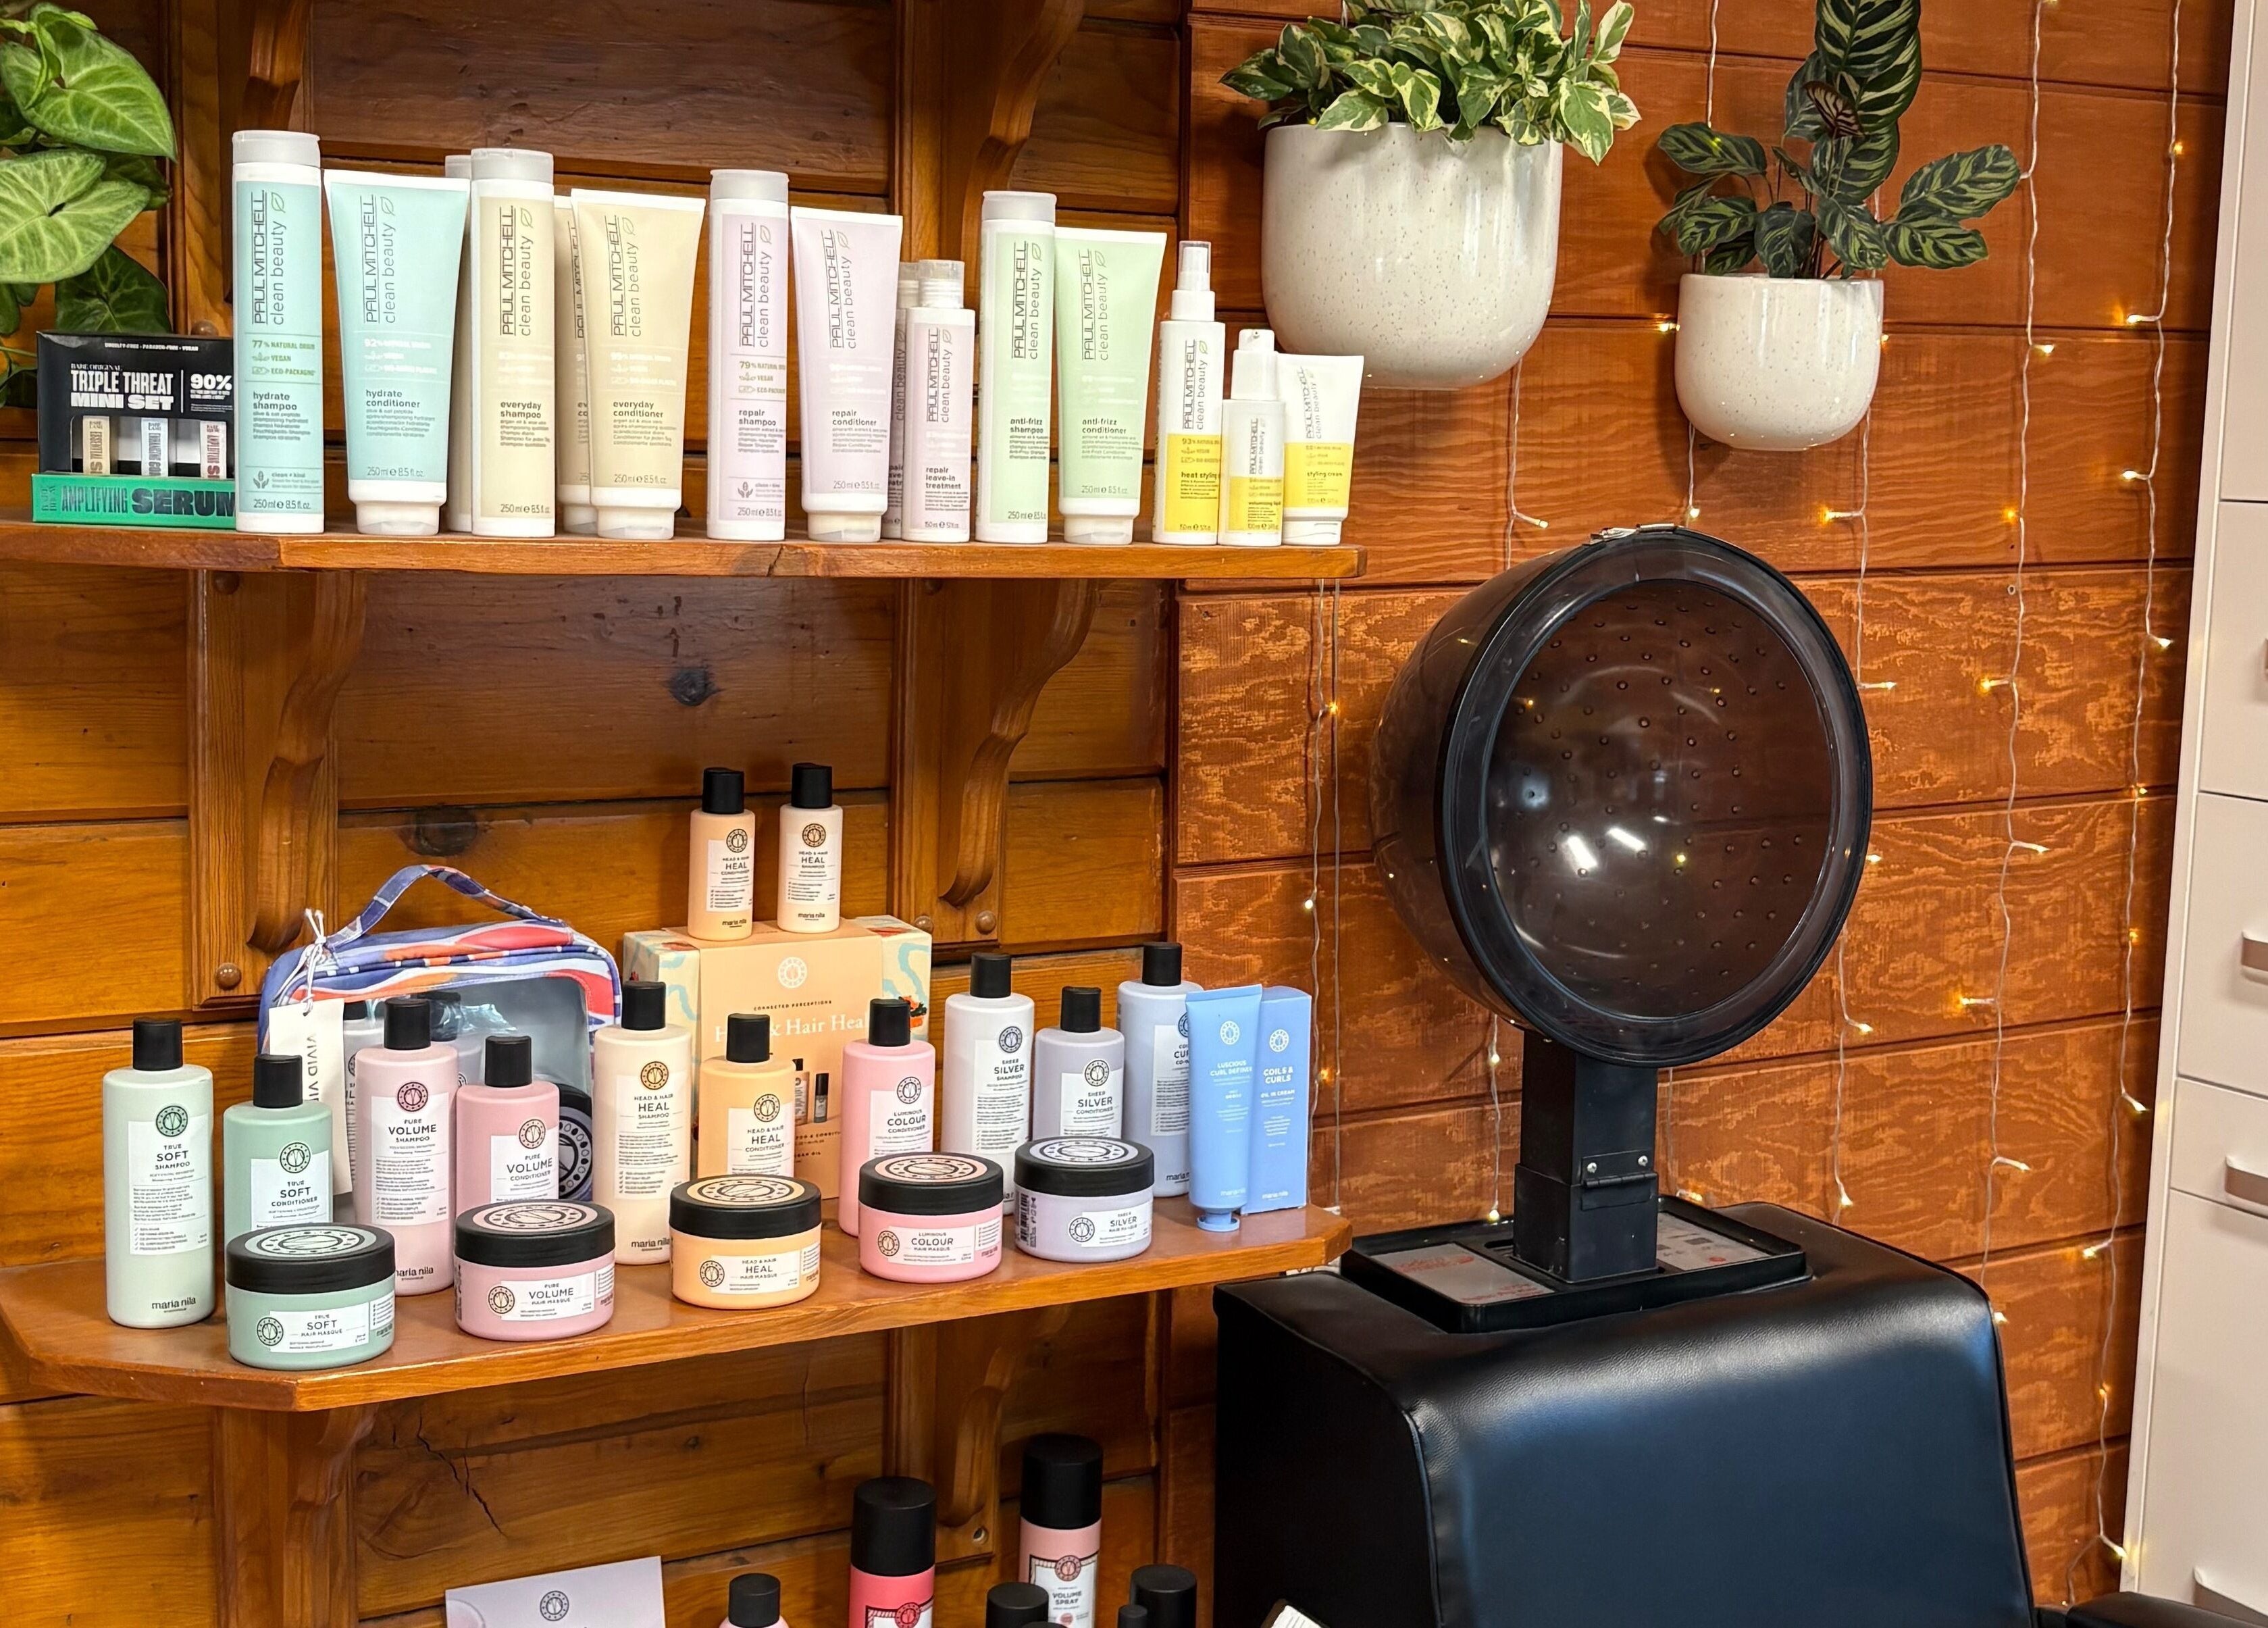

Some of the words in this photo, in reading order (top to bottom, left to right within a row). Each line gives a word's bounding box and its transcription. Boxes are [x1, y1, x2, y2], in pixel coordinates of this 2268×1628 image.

[254, 190, 265, 276] MITCHELL
[363, 195, 377, 276] MITCHELL
[270, 220, 286, 278] beauty
[382, 223, 396, 277] beauty
[502, 205, 514, 288] MITCHELL
[607, 215, 623, 290] MITCHELL
[519, 235, 534, 290] beauty
[626, 241, 639, 292] beauty
[742, 223, 754, 303] MITCHELL
[822, 229, 839, 305] MITCHELL
[758, 251, 772, 303] beauty
[840, 256, 854, 307] beauty
[1014, 240, 1027, 316] MITCHELL
[1082, 249, 1093, 320] MITCHELL
[365, 279, 378, 323] PAUL
[1029, 268, 1042, 317] beauty
[1097, 274, 1108, 320] beauty
[254, 279, 265, 324] PAUL
[270, 282, 284, 326] clean
[383, 282, 396, 324] clean
[502, 291, 514, 336] PAUL
[519, 295, 532, 336] clean
[613, 293, 625, 336] PAUL
[629, 297, 642, 337] clean
[742, 305, 753, 347] PAUL
[756, 308, 769, 348] clean
[831, 308, 842, 349] PAUL
[844, 311, 856, 349] clean
[1014, 320, 1025, 359] PAUL
[1028, 322, 1039, 359] clean
[1083, 322, 1093, 360] PAUL
[1098, 325, 1108, 361] clean
[929, 328, 939, 388] MITCHELL
[895, 349, 906, 388] beauty
[941, 349, 952, 389] beauty
[1185, 339, 1196, 397] MITCHELL
[71, 370, 120, 393] TRIPLE
[123, 372, 174, 395] THREAT
[190, 374, 232, 390] 90%
[1197, 360, 1208, 398] beauty
[71, 392, 124, 409] MINI
[128, 394, 174, 411] SET
[253, 391, 290, 402] hydrate
[365, 389, 403, 399] hydrate
[253, 401, 297, 411] shampoo
[365, 399, 420, 408] conditioner
[500, 401, 542, 411] everyday
[613, 401, 654, 410] everyday
[895, 391, 905, 421] clean
[929, 391, 937, 422] PAUL
[941, 392, 950, 423] clean
[500, 410, 542, 419] shampoo
[613, 409, 663, 418] conditioner
[739, 409, 765, 417] repair
[739, 417, 776, 426] shampoo
[832, 409, 857, 417] repair
[1184, 399, 1193, 429] PAUL
[1195, 401, 1205, 430] clean
[832, 418, 877, 426] conditioner
[1010, 426, 1043, 434] shampoo
[1082, 426, 1127, 434] conditioner
[62, 486, 128, 513] AMPLIFYING
[131, 488, 235, 517] SERUM
[253, 499, 267, 509] 250
[725, 862, 748, 870] HEAL
[786, 1018, 825, 1036] Hair
[307, 1033, 318, 1076] VIVID
[994, 1064, 1025, 1075] SILVER
[1217, 1060, 1247, 1069] LUSCIOUS
[1263, 1067, 1287, 1076] COILS
[1265, 1075, 1291, 1084] CURLS
[1277, 1089, 1295, 1097] CREAM
[638, 1102, 670, 1113] HEAL
[1076, 1106, 1114, 1115] CONDITIONER
[1077, 1096, 1113, 1108] SILVER
[887, 1115, 927, 1126] COLOUR
[894, 1109, 923, 1117] LUMINOUS
[388, 1124, 438, 1136] VOLUME
[888, 1125, 926, 1134] CONDITIONER
[745, 1143, 785, 1152] CONDITIONER
[751, 1134, 781, 1145] HEAL
[156, 1150, 190, 1163] SOFT
[155, 1161, 191, 1171] SHAMPOO
[507, 1157, 553, 1174] VOLUME
[510, 1170, 551, 1181] CONDITIONER
[1166, 1173, 1186, 1181] maria
[280, 1186, 312, 1199] SOFT
[271, 1196, 319, 1208] CONDITIONER
[1110, 1216, 1137, 1227] SILVER
[631, 1239, 656, 1248] maria
[911, 1237, 954, 1246] COLOUR
[418, 1266, 434, 1275] nila
[746, 1265, 773, 1274] HEAL
[529, 1288, 574, 1300] VOLUME
[151, 1298, 180, 1310] maria
[180, 1296, 197, 1307] nila
[307, 1320, 338, 1330] SOFT
[1052, 1590, 1082, 1599] VOLUME
